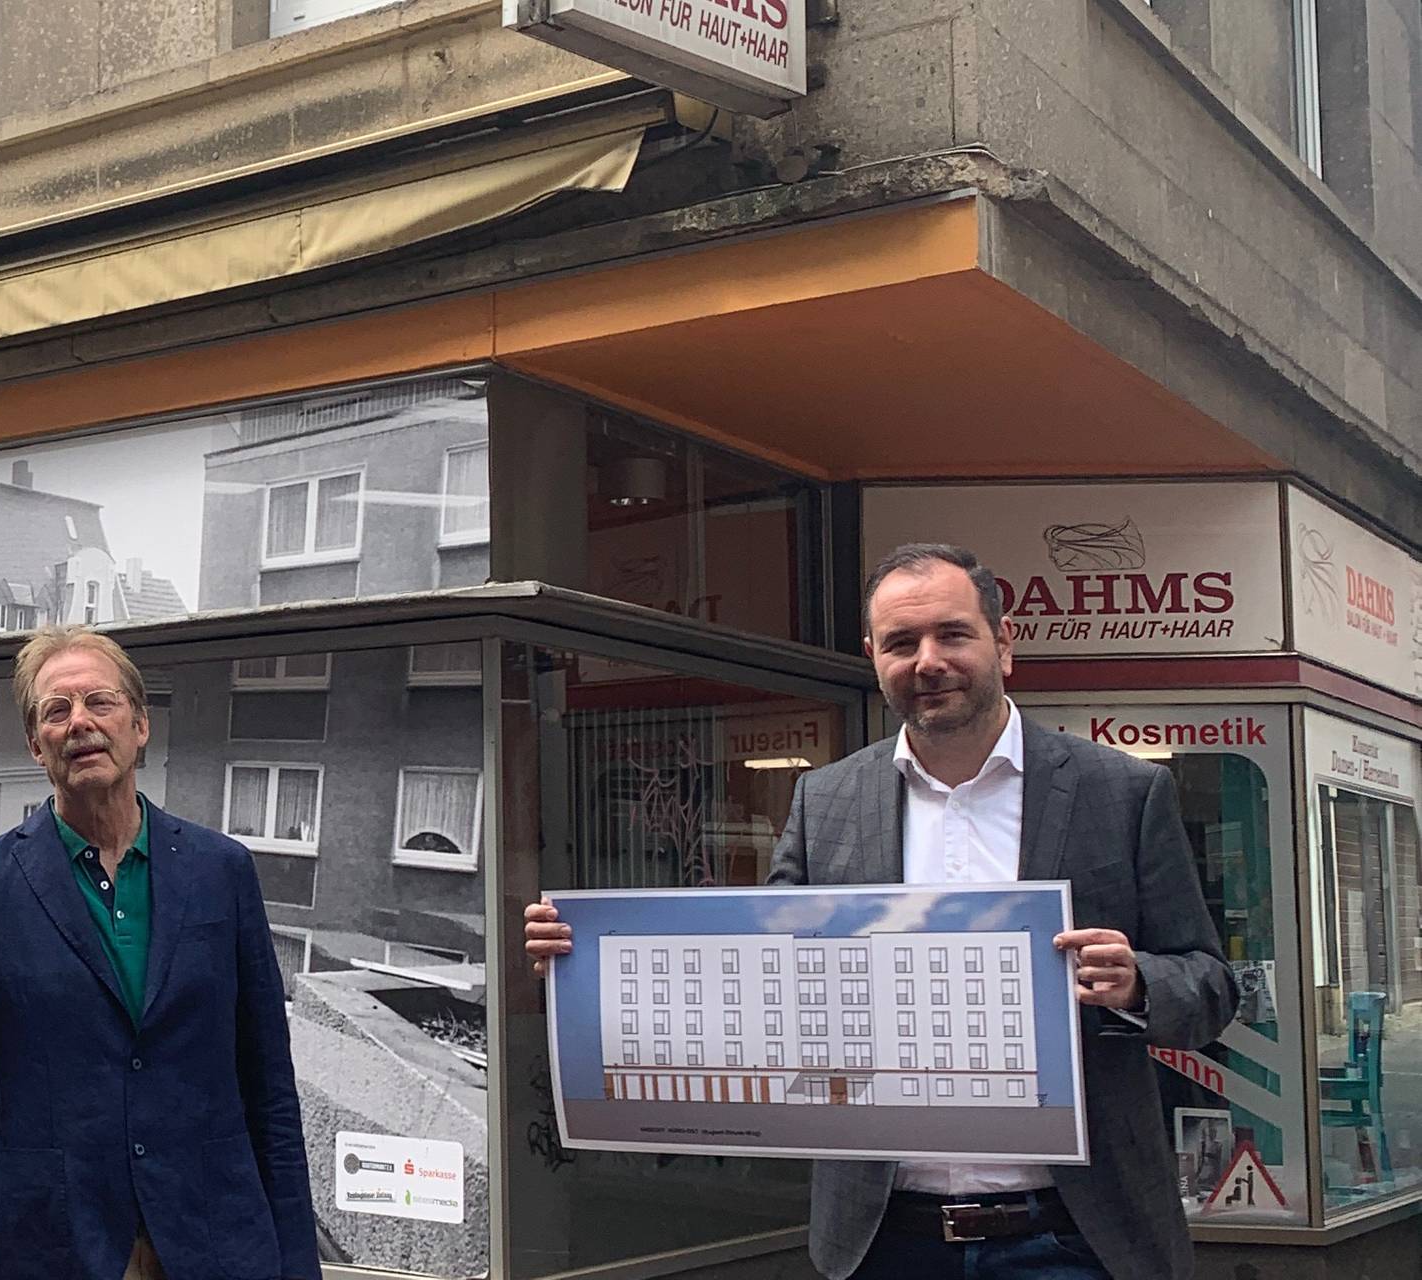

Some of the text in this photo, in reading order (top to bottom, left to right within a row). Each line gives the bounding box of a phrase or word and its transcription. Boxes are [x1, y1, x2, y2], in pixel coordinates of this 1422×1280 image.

[698, 10, 789, 68] HAUT+HAAR
[1346, 564, 1395, 626] DAHMS
[1046, 618, 1091, 640] FÜR
[1100, 619, 1234, 639] HAUT+HAAR
[1091, 717, 1267, 746] Kosmetik
[418, 1168, 457, 1180] Sparkasse
